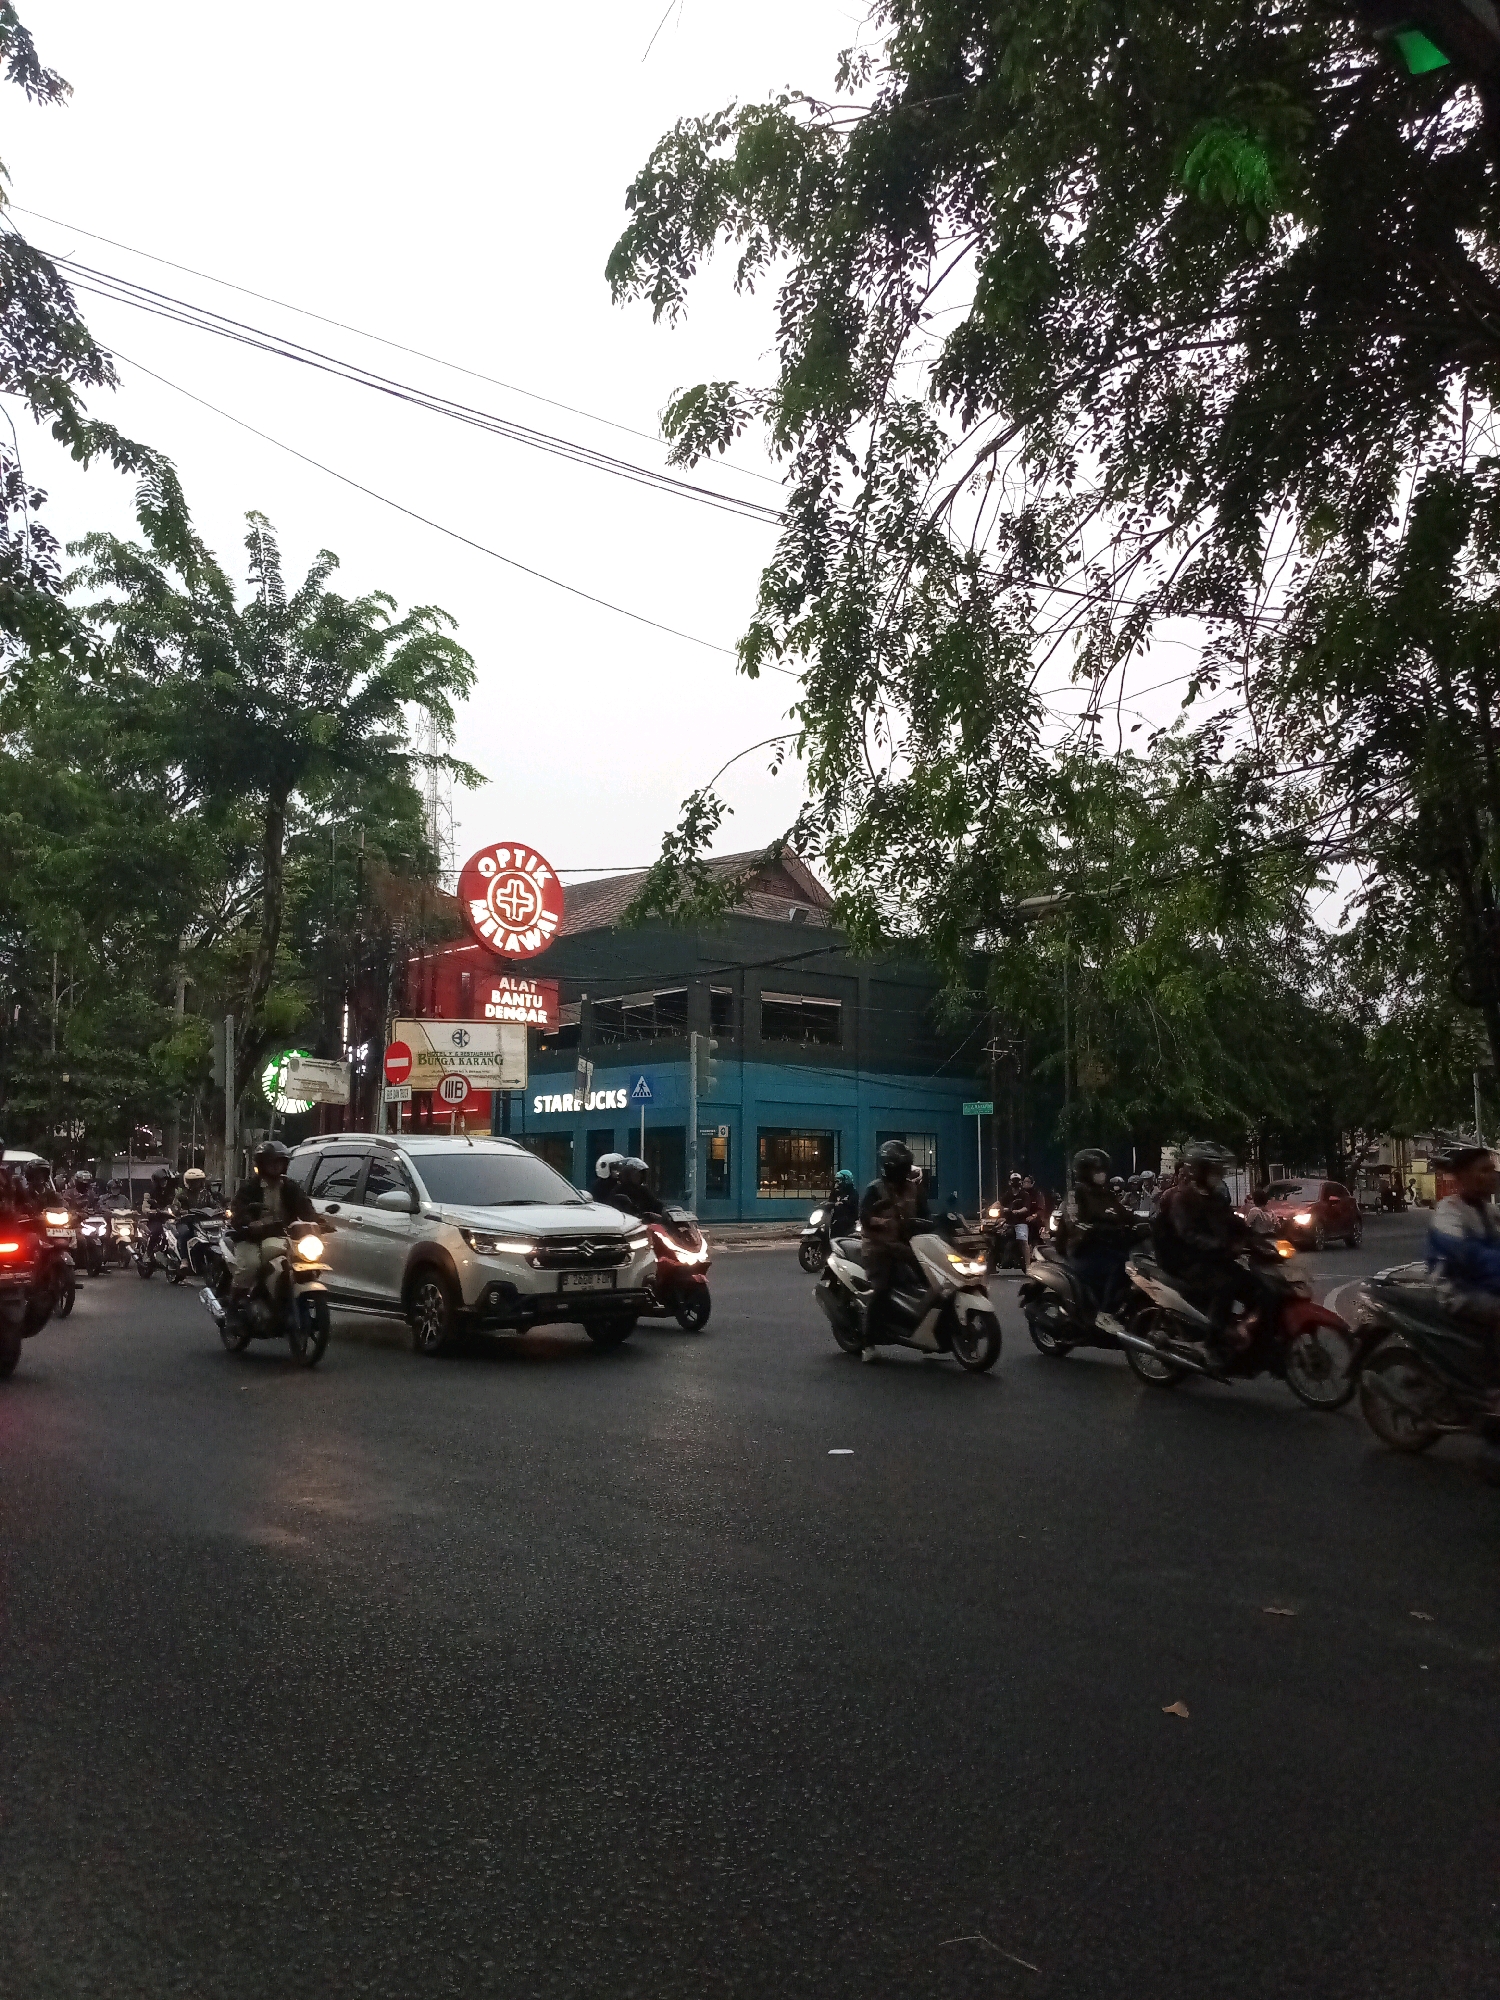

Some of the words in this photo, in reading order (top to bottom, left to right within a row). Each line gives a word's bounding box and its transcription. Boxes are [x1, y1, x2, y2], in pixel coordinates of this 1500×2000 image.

[478, 848, 552, 889] OPTIK
[499, 977, 537, 993] ALAT
[491, 989, 543, 1008] BANTU
[485, 1003, 548, 1023] DENGAR
[418, 1053, 455, 1066] BUNGA
[458, 1053, 504, 1066] KARANG
